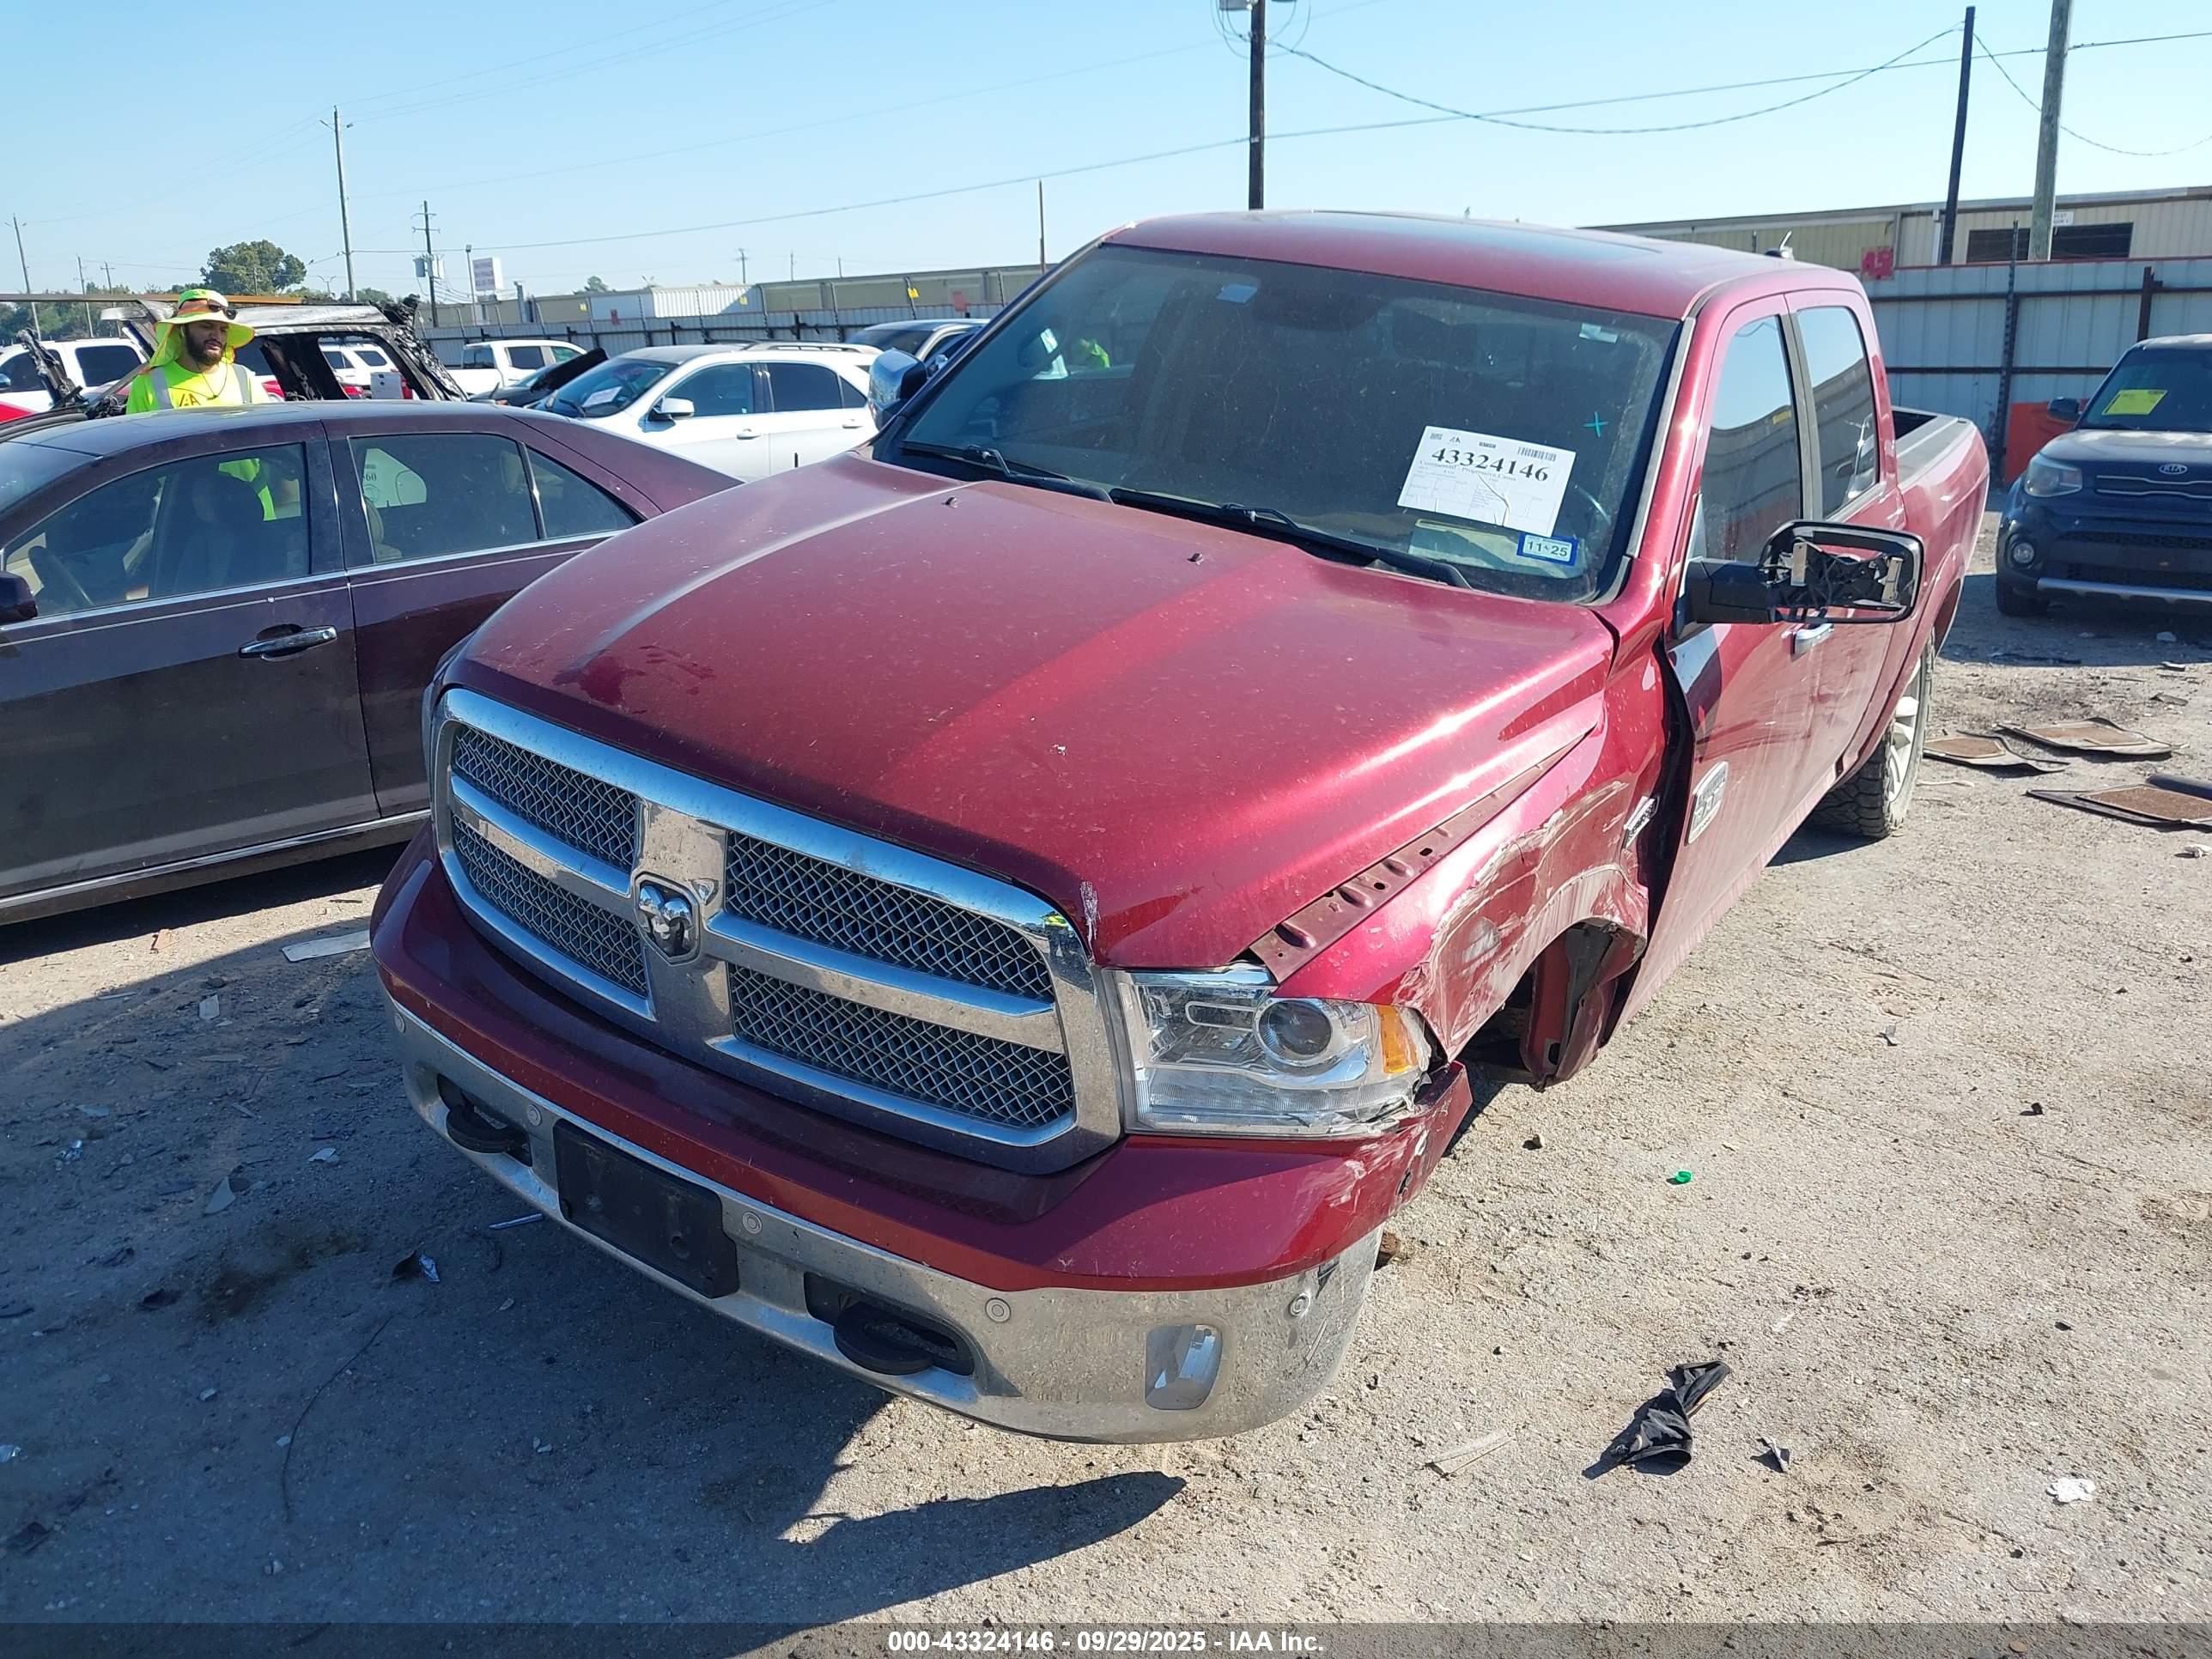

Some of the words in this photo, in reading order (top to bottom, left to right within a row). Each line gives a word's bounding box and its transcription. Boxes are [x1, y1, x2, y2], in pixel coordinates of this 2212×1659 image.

[1431, 447, 1550, 482] 43324146
[2161, 464, 2184, 473] KIA
[362, 472, 377, 482] 60
[1528, 540, 1542, 553] 11
[1551, 545, 1568, 557] 25
